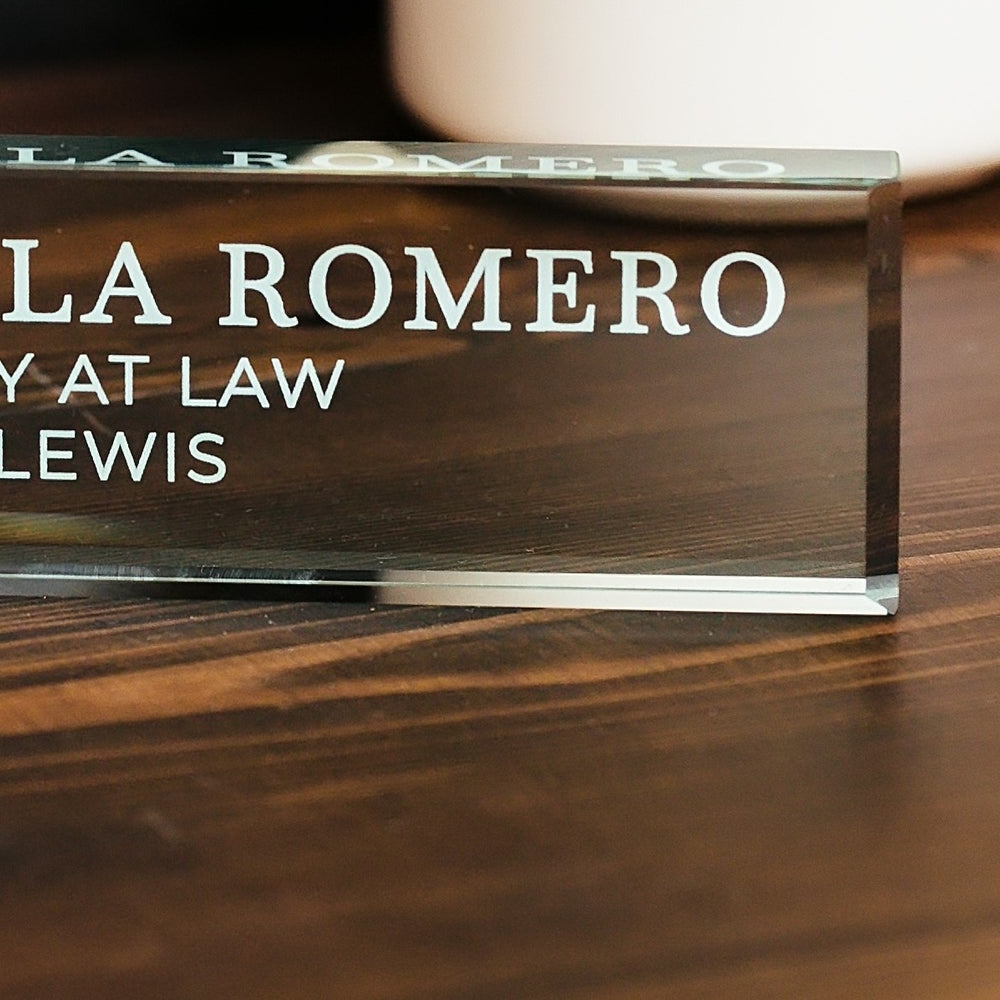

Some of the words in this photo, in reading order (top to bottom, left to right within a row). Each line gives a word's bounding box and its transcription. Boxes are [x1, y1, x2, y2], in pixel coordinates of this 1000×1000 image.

[222, 151, 787, 180] ROMERO
[218, 242, 787, 338] ROMERO
[57, 353, 151, 406] AT
[181, 356, 346, 410] LAW
